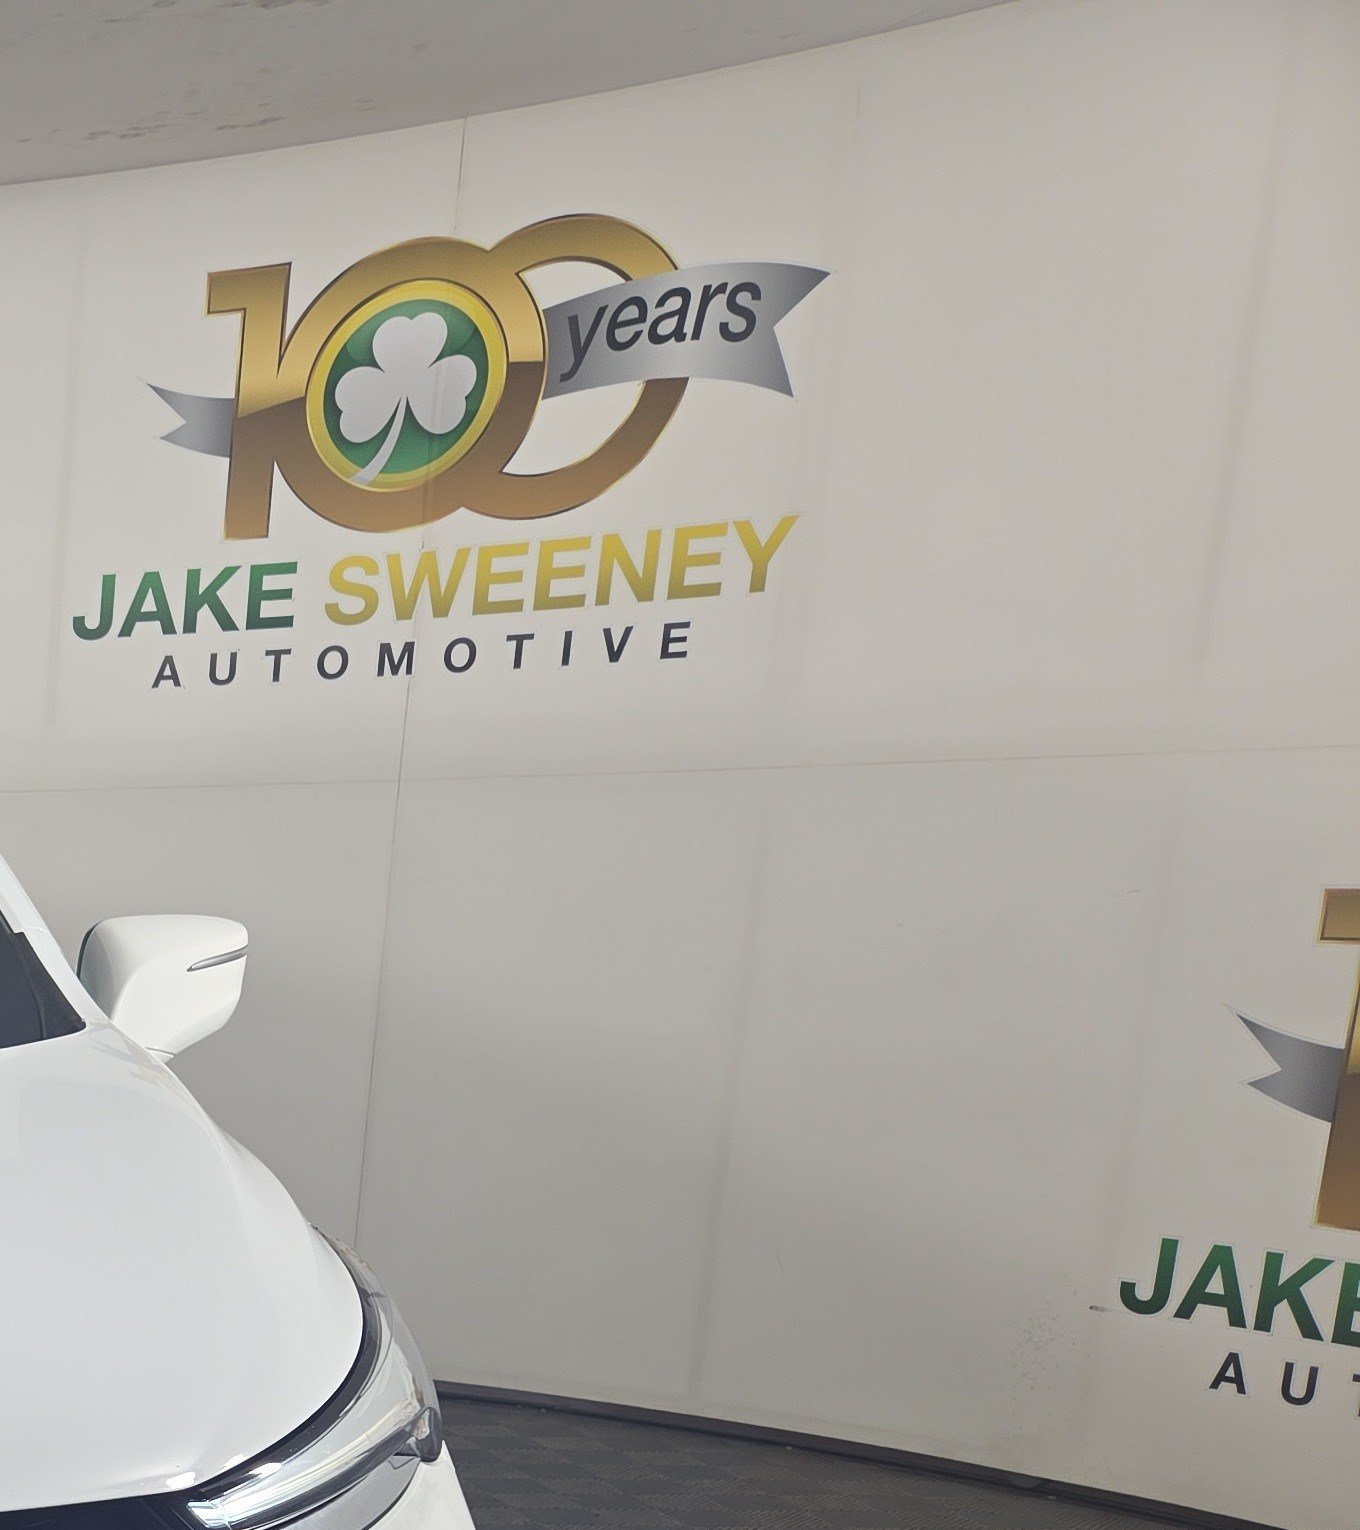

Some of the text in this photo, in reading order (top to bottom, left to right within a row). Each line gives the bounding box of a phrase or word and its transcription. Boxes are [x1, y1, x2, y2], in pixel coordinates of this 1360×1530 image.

[559, 279, 762, 382] years
[72, 515, 798, 641] JAKE SWEENEY
[152, 621, 691, 689] AUTOMOTIVE
[1209, 1352, 1360, 1417] AU
